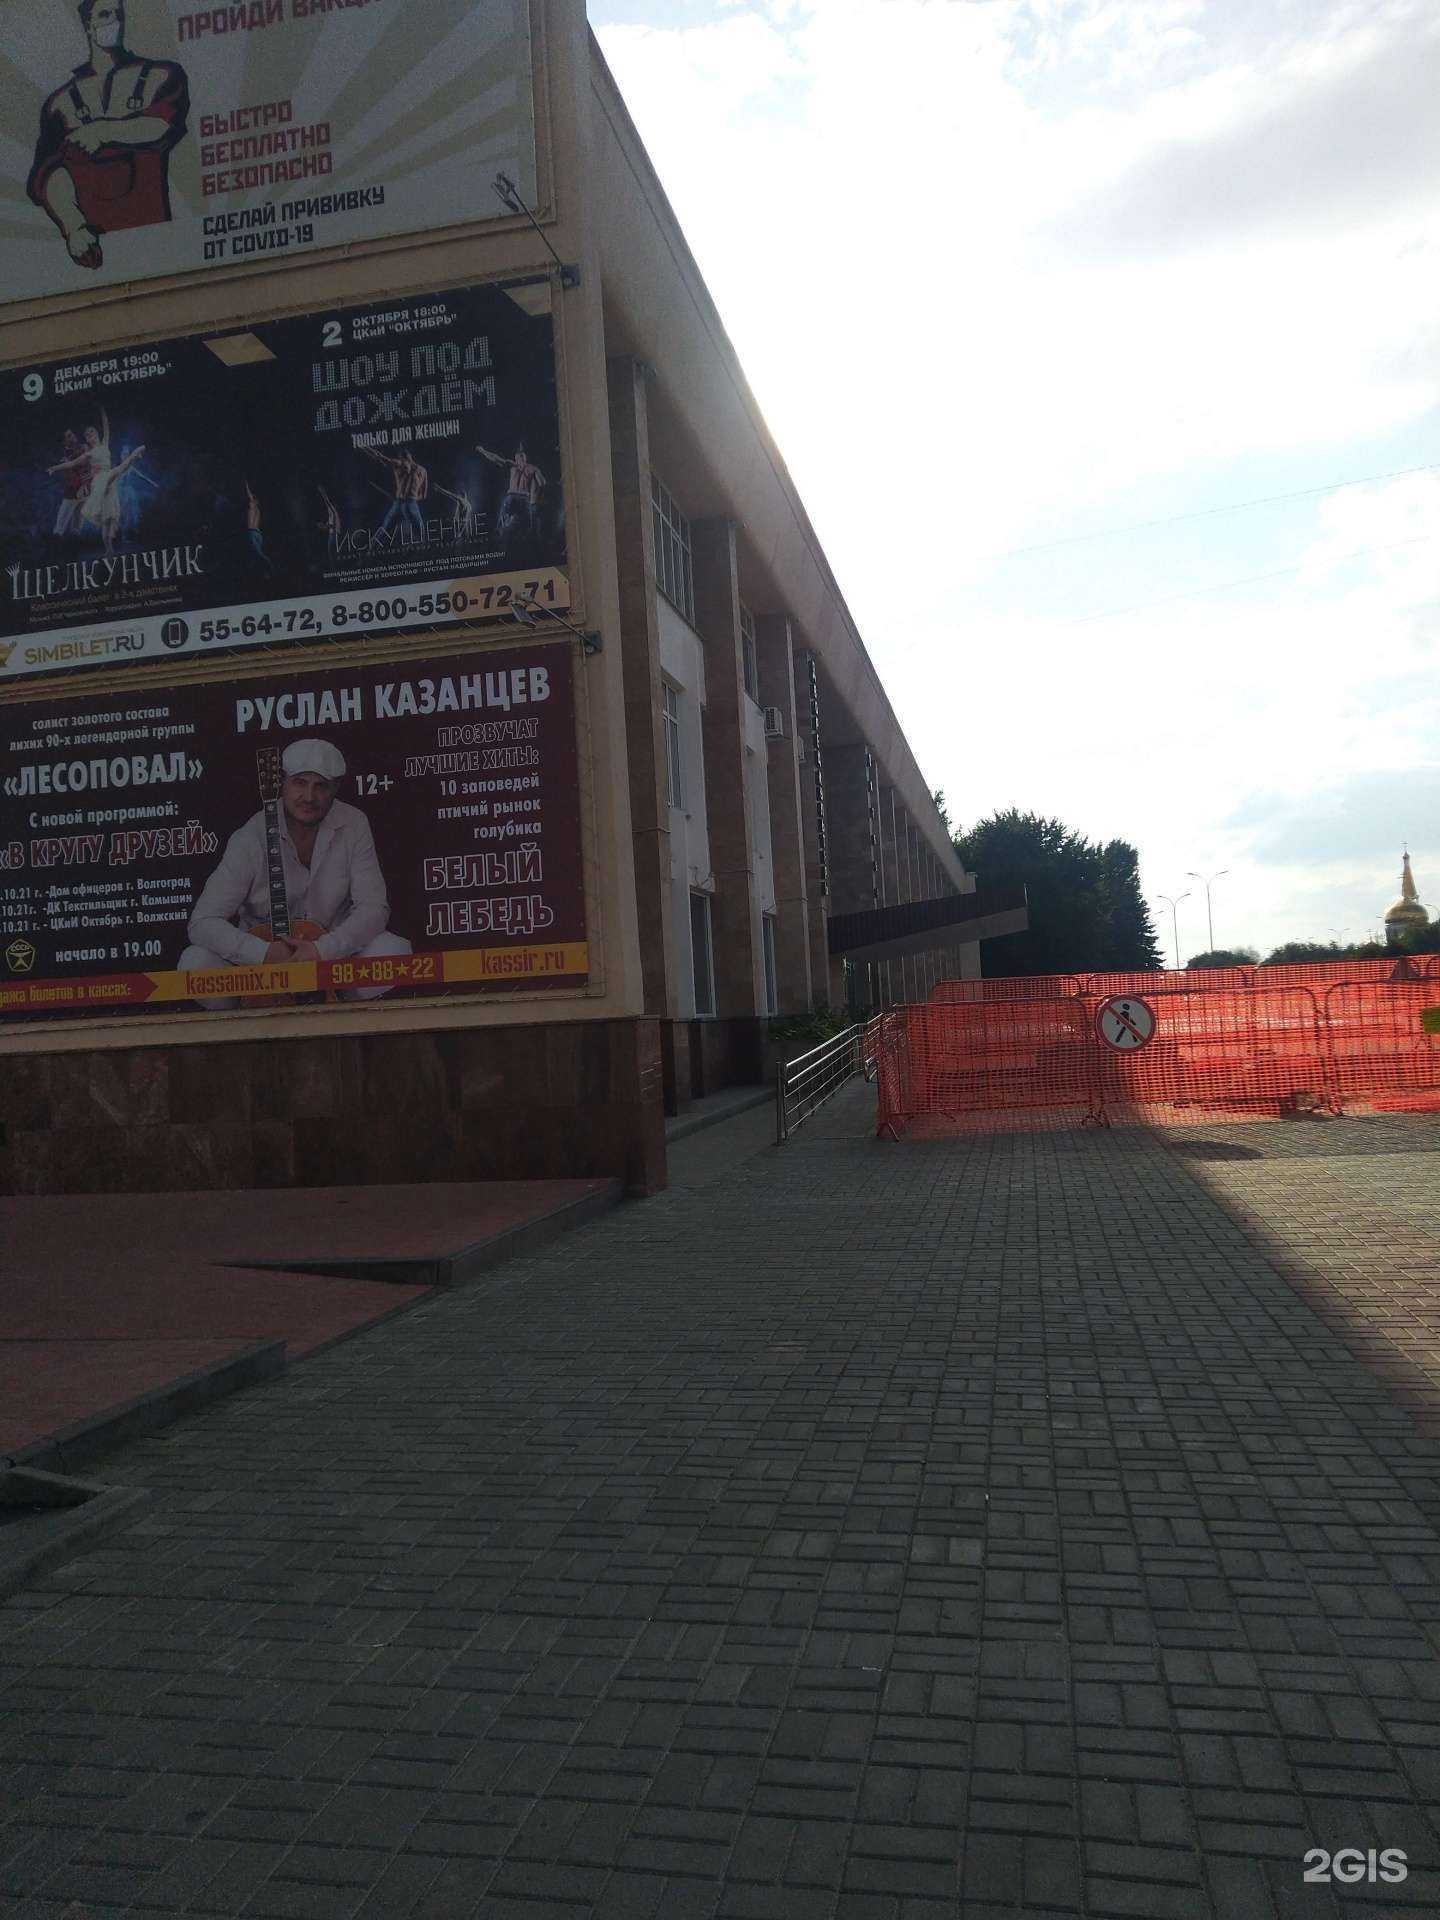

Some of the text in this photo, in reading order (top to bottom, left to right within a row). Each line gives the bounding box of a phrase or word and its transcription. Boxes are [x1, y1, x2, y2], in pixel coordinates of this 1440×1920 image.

[200, 100, 292, 138] БЫСТРО
[201, 122, 331, 167] БЕСПЛАТНО
[202, 152, 332, 196] БЕЗОПАСНО
[203, 185, 385, 235] СДЕЛАЙ ПРИВИВКУ
[204, 223, 313, 260] ОТ COVID-19
[352, 304, 446, 328] ОКТЯБРЯ 18:00
[389, 313, 457, 333] "ОКТЯБРЬ"
[321, 320, 343, 347] 2
[54, 351, 159, 383] ДЕКАБРЯ 19:00
[96, 362, 172, 385] "ОКТЯБРЬ"
[312, 336, 494, 392] ШОУ ПОД
[22, 373, 44, 402] 9
[312, 366, 497, 432] ДОЖДЁМ
[352, 419, 460, 449] ТОЛЬКО ДЛЯ ЖЕНЩИН
[335, 512, 489, 552] ИСКУШЕНИЕ
[6, 545, 205, 600] ЩЕЛКУНЧИК
[25, 633, 145, 665] SIMBILET.RU
[235, 666, 551, 733] РУСЛАН КАЗАНЦЕВ
[32, 706, 170, 731] солист золотого состава
[437, 717, 539, 748] ПРОЗВУЧАТ
[9, 723, 195, 752] лихих 90-х легендарной группы
[4, 752, 204, 796] «ЛЕСОПОВАЛ»
[403, 745, 540, 778] ЛУЧШИЕ ХИТЫ:
[355, 773, 394, 796] 12+
[440, 772, 540, 796] 10 заповедей
[29, 801, 179, 829] С новой программой:
[437, 799, 542, 819] птичий рынок
[31, 834, 104, 867] КРУГУ
[108, 820, 219, 866] ДРУЗЕЙ»
[473, 819, 542, 840] голубика
[423, 842, 543, 891] БЕЛЫЙ
[73, 881, 123, 897] офицеров
[136, 876, 192, 891] Волгоград
[64, 900, 128, 914] Текстильщик
[141, 894, 193, 907] Камышин
[81, 914, 123, 928] Октябрь
[136, 908, 188, 923] Волжский
[426, 895, 554, 936] ЛЕБЕДЬ
[56, 940, 162, 962] начало в 19.00
[480, 949, 565, 976] kassir.ru
[29, 983, 74, 1001] билетов
[77, 988, 85, 999] в
[186, 968, 289, 996] kassamix.ru
